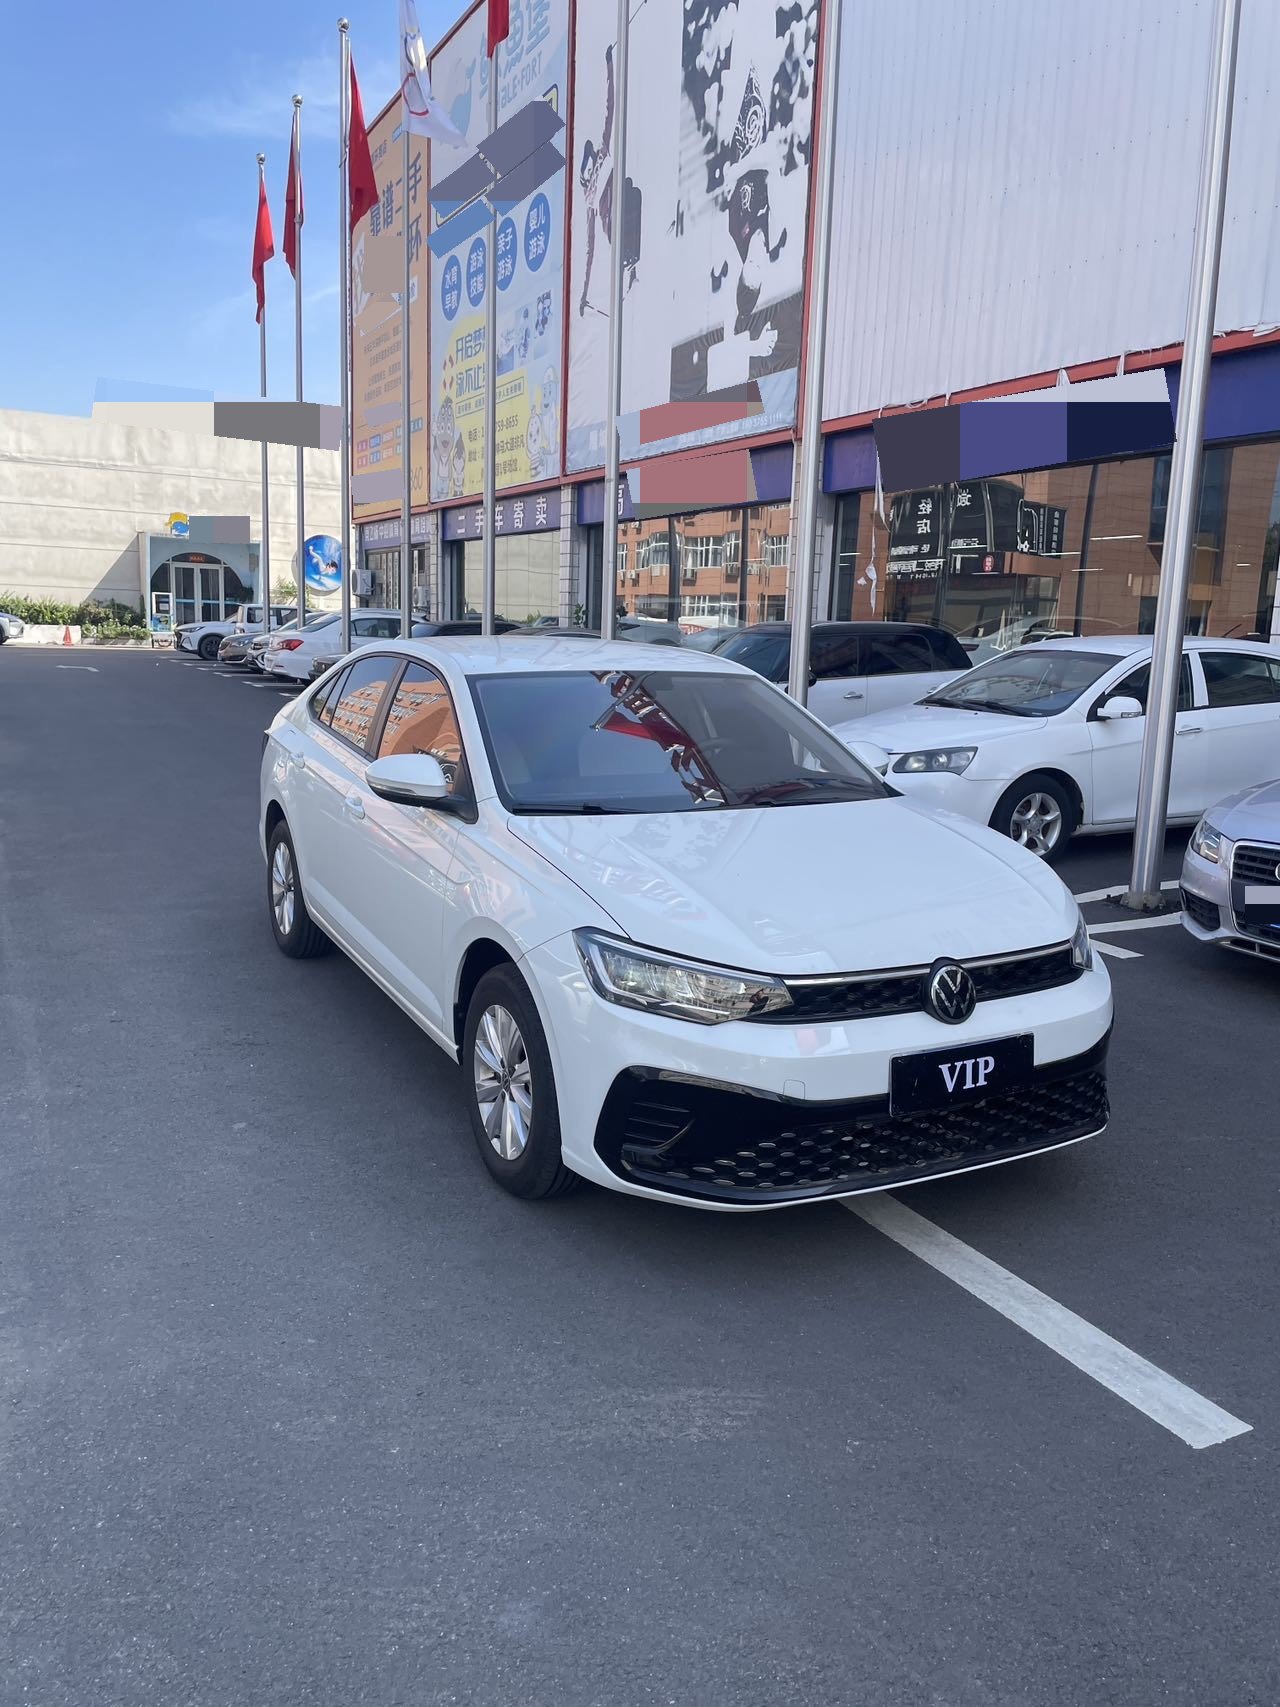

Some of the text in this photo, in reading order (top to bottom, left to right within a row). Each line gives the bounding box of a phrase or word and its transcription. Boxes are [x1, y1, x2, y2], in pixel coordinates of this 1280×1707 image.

[457, 496, 547, 534] 二手车寄卖
[938, 1056, 995, 1093] VIP
